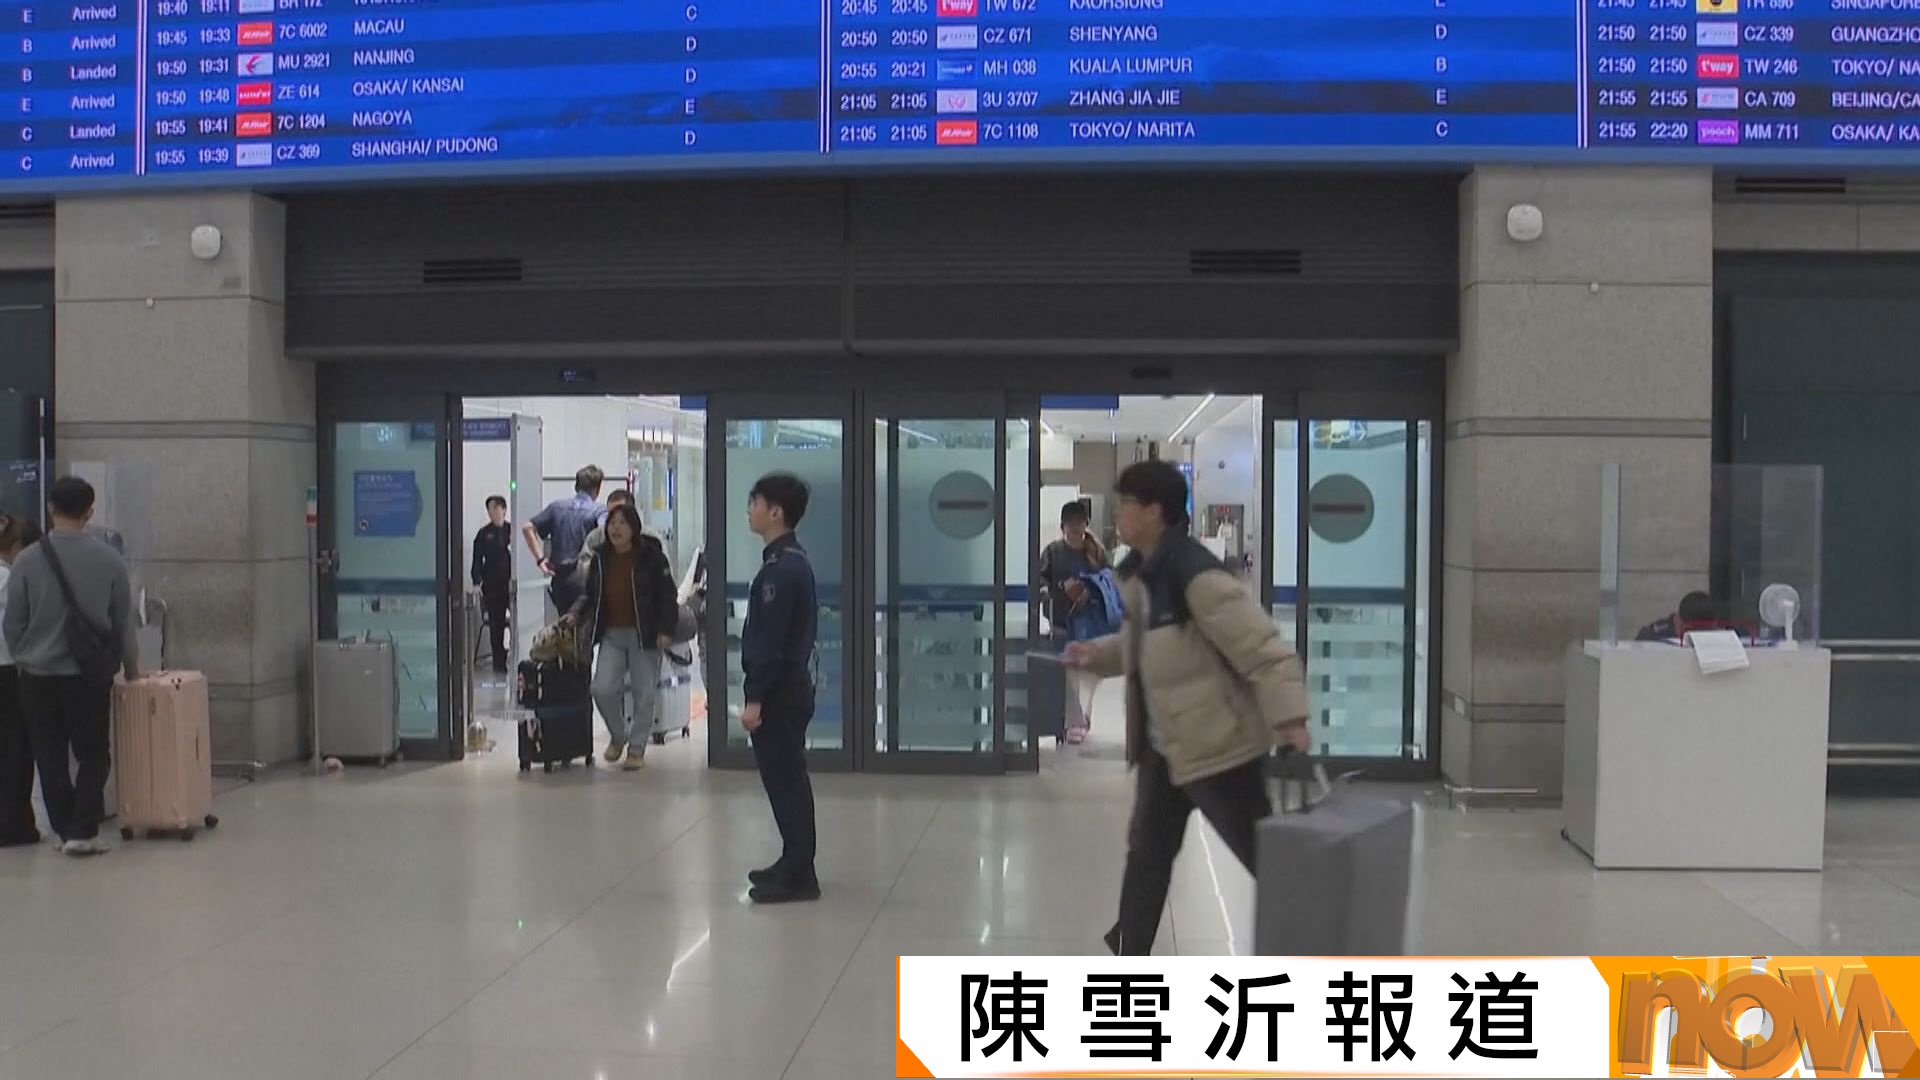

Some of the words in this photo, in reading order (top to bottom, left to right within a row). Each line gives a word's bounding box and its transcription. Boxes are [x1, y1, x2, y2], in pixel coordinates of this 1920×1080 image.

[24, 10, 31, 22] E
[73, 5, 116, 20] Arrived
[158, 0, 187, 15] 19:40
[842, 0, 876, 14] 20:45
[892, 0, 927, 13] 20:45
[157, 31, 187, 45] 19:45
[200, 28, 230, 43] 19:33
[280, 25, 295, 38] 7C
[300, 23, 327, 37] 6002
[355, 19, 404, 34] MACAU
[687, 6, 696, 20] C
[1599, 25, 1635, 40] 21:50
[1650, 26, 1686, 40] 21:50
[1745, 26, 1765, 40] CZ
[1770, 26, 1794, 41] 339
[23, 39, 32, 52] B
[72, 35, 115, 49] Arrived
[842, 31, 877, 46] 20:50
[892, 30, 927, 45] 20:50
[984, 29, 1004, 43] CZ
[1009, 28, 1030, 42] 671
[1070, 26, 1157, 41] SHENYANG
[1436, 25, 1447, 39] D
[157, 61, 186, 75] 19:50
[200, 59, 228, 73] 19:31
[279, 55, 299, 69] MU
[304, 53, 329, 67] 2921
[354, 49, 414, 65] NANJING
[687, 37, 696, 51] D
[22, 69, 31, 81] B
[71, 64, 116, 79] Landed
[842, 63, 876, 78] 20:55
[892, 62, 925, 77] 20:21
[984, 60, 1007, 74] MH
[1013, 60, 1036, 74] 038
[1070, 59, 1121, 73] KUALA
[1127, 58, 1192, 72] LUMPUR
[1436, 57, 1446, 71] B
[1599, 58, 1635, 73] 21:50
[1651, 58, 1687, 73] 21:50
[1746, 59, 1769, 73] TW
[1774, 59, 1797, 74] 246
[1833, 59, 1894, 76] TOKYO/
[157, 91, 186, 104] 19:50
[278, 86, 294, 99] ZE
[299, 84, 319, 98] 614
[353, 79, 407, 96] OSAKA/
[413, 78, 463, 93] KANSAI
[686, 69, 696, 82] D
[22, 98, 30, 111] E
[72, 94, 114, 109] Arrived
[841, 95, 876, 109] 21:05
[892, 94, 926, 108] 21:05
[983, 92, 1001, 107] 3U
[1008, 92, 1038, 106] 3707
[1070, 91, 1124, 105] ZHANG
[1130, 90, 1152, 105] JIA
[1157, 90, 1179, 104] JIE
[1437, 89, 1446, 104] E
[1600, 90, 1636, 105] 21:55
[1651, 90, 1687, 106] 21:55
[1745, 92, 1767, 106] CA
[1772, 92, 1795, 106] 709
[156, 120, 185, 135] 19:55
[199, 118, 227, 133] 19:41
[278, 116, 293, 129] 7C
[300, 114, 325, 128] 1204
[353, 110, 412, 126] NAGOYA
[686, 100, 694, 113] E
[22, 127, 31, 140] C
[70, 124, 115, 138] Landed
[841, 127, 876, 141] 21:05
[891, 125, 926, 140] 21:05
[984, 124, 1002, 138] 7C
[1009, 124, 1038, 138] 1108
[1071, 121, 1132, 138] TOKYO/
[1138, 122, 1194, 136] NARITA
[1436, 122, 1447, 136] C
[1600, 122, 1636, 137] 21:55
[1651, 123, 1687, 138] 22:20
[1746, 124, 1771, 138] MM
[1777, 124, 1798, 139] 711
[1832, 124, 1893, 141] OSAKA/
[156, 150, 185, 164] 19:55
[199, 148, 228, 162] 19:39
[277, 146, 295, 159] CZ
[299, 144, 320, 158] 369
[352, 139, 431, 156] SHANGHAI/
[437, 138, 497, 152] PUDONG
[685, 131, 695, 144] D
[21, 156, 31, 170] C
[71, 154, 114, 168] Arrived
